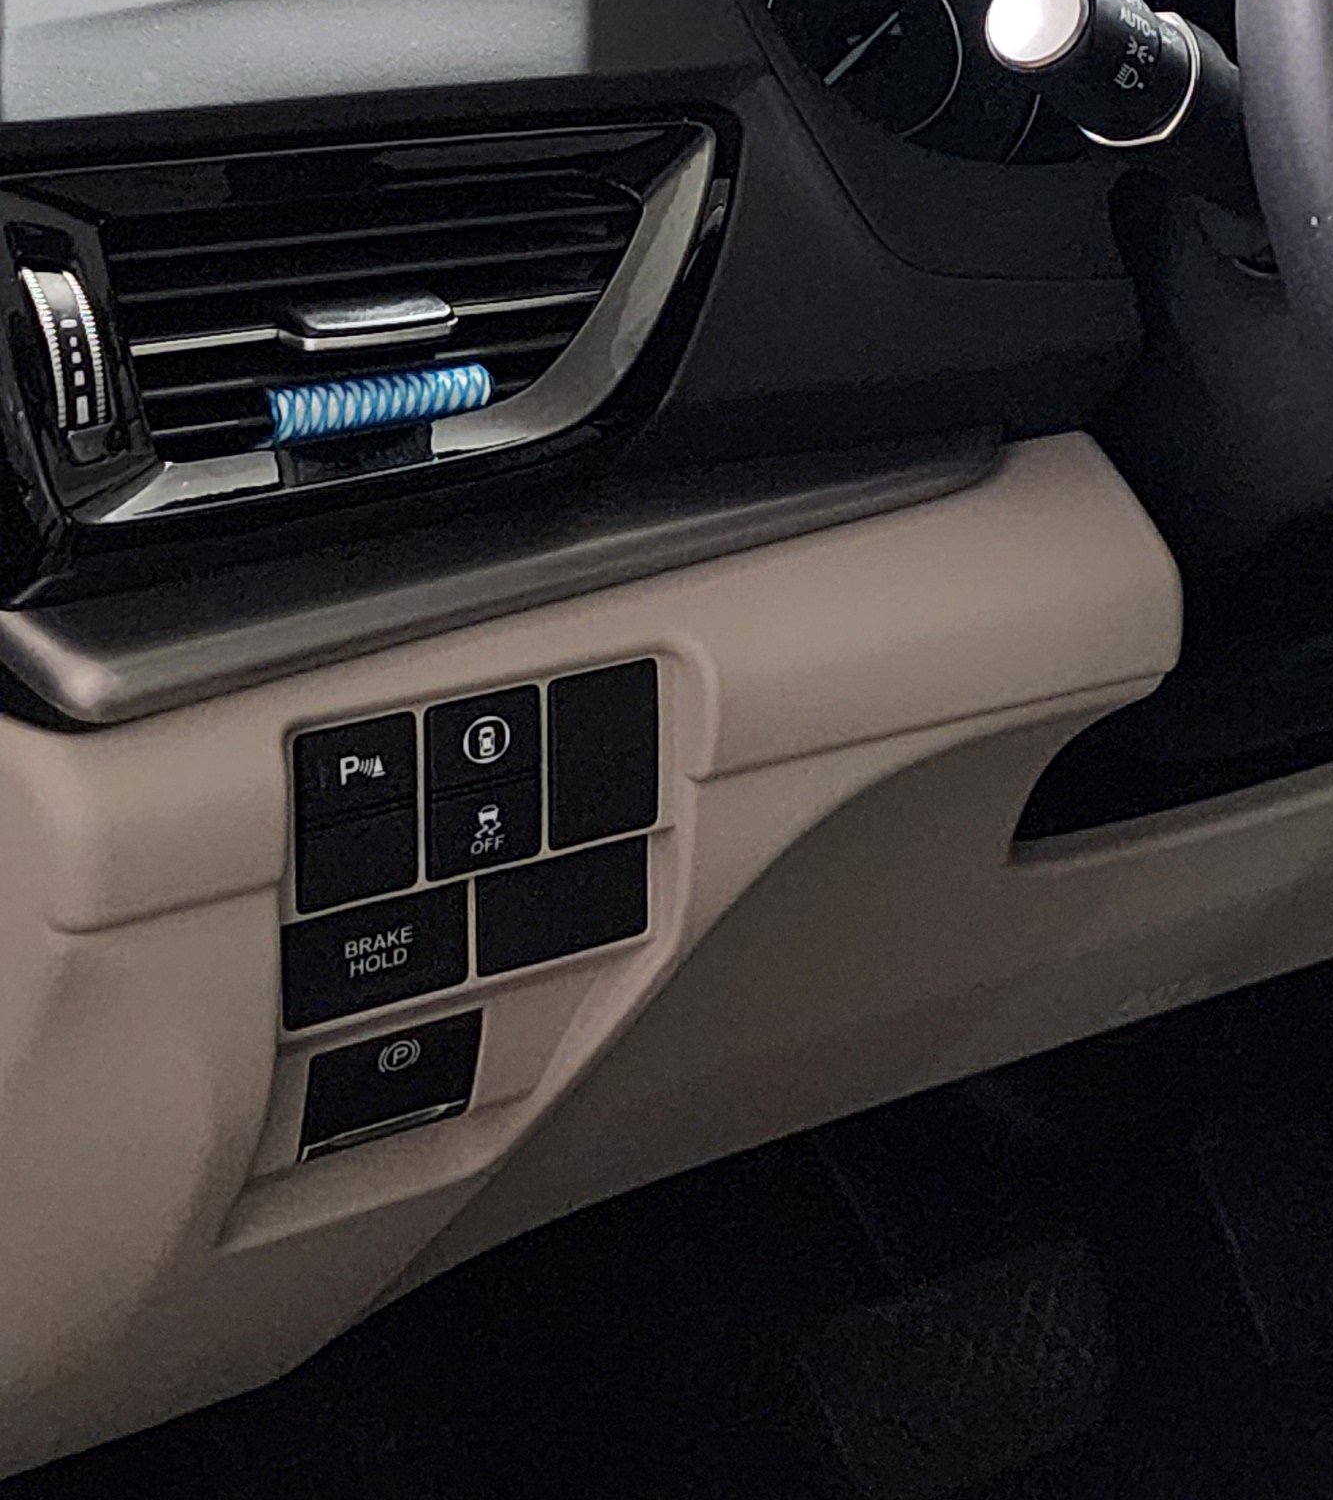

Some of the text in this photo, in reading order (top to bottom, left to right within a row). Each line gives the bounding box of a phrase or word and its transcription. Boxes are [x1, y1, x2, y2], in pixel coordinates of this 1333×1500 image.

[1120, 6, 1151, 37] AUTO
[470, 833, 505, 856] OFF
[344, 924, 414, 959] BRAKE
[349, 947, 408, 979] HOLD
